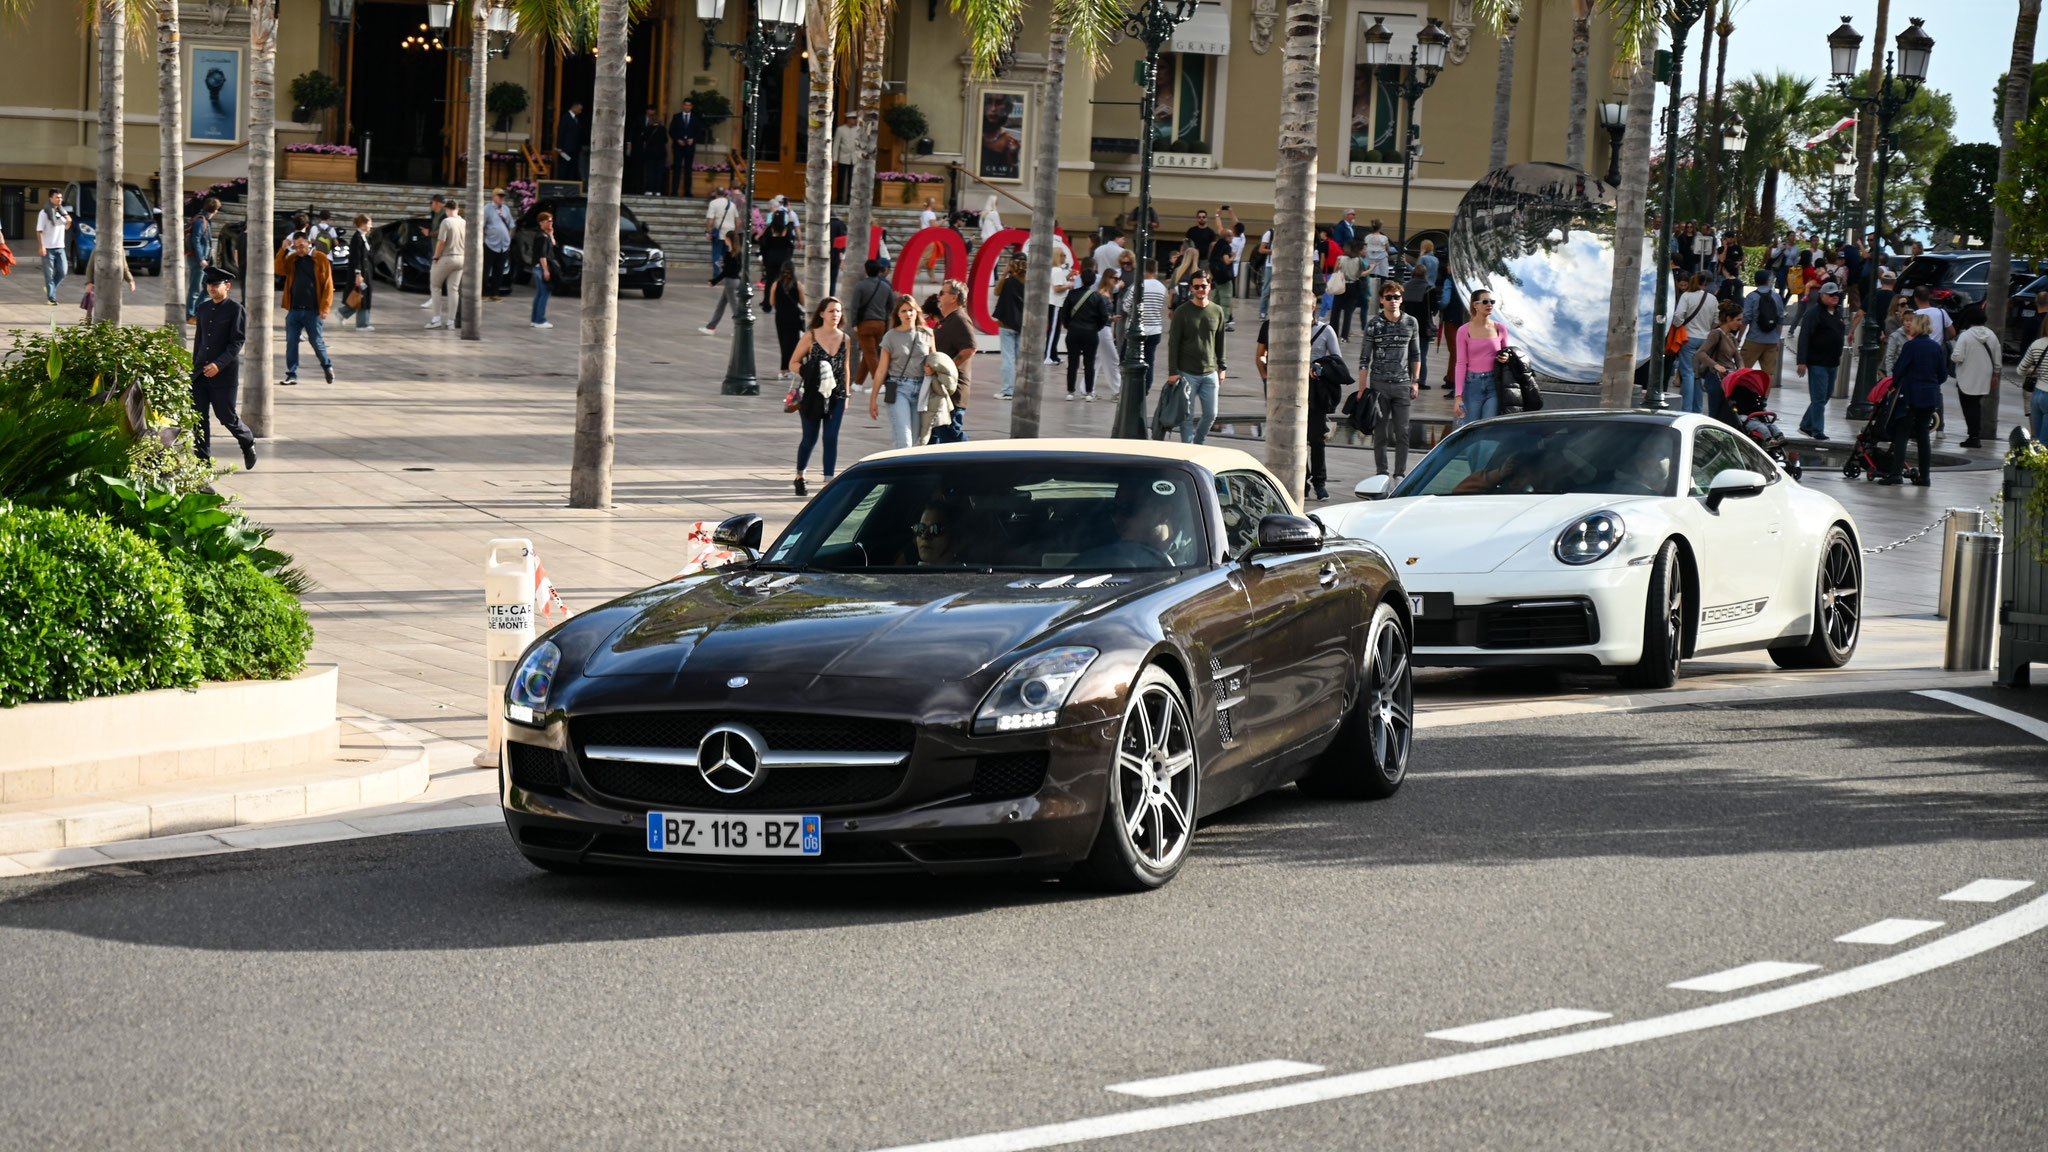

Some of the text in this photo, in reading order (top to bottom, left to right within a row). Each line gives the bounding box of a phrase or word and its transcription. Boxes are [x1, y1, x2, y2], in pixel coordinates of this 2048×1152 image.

[1176, 41, 1227, 53] GRAFF
[1157, 155, 1208, 167] GRAFF
[1355, 165, 1404, 176] GRAFF
[1708, 603, 1754, 620] PORSCHE
[804, 836, 818, 850] 06
